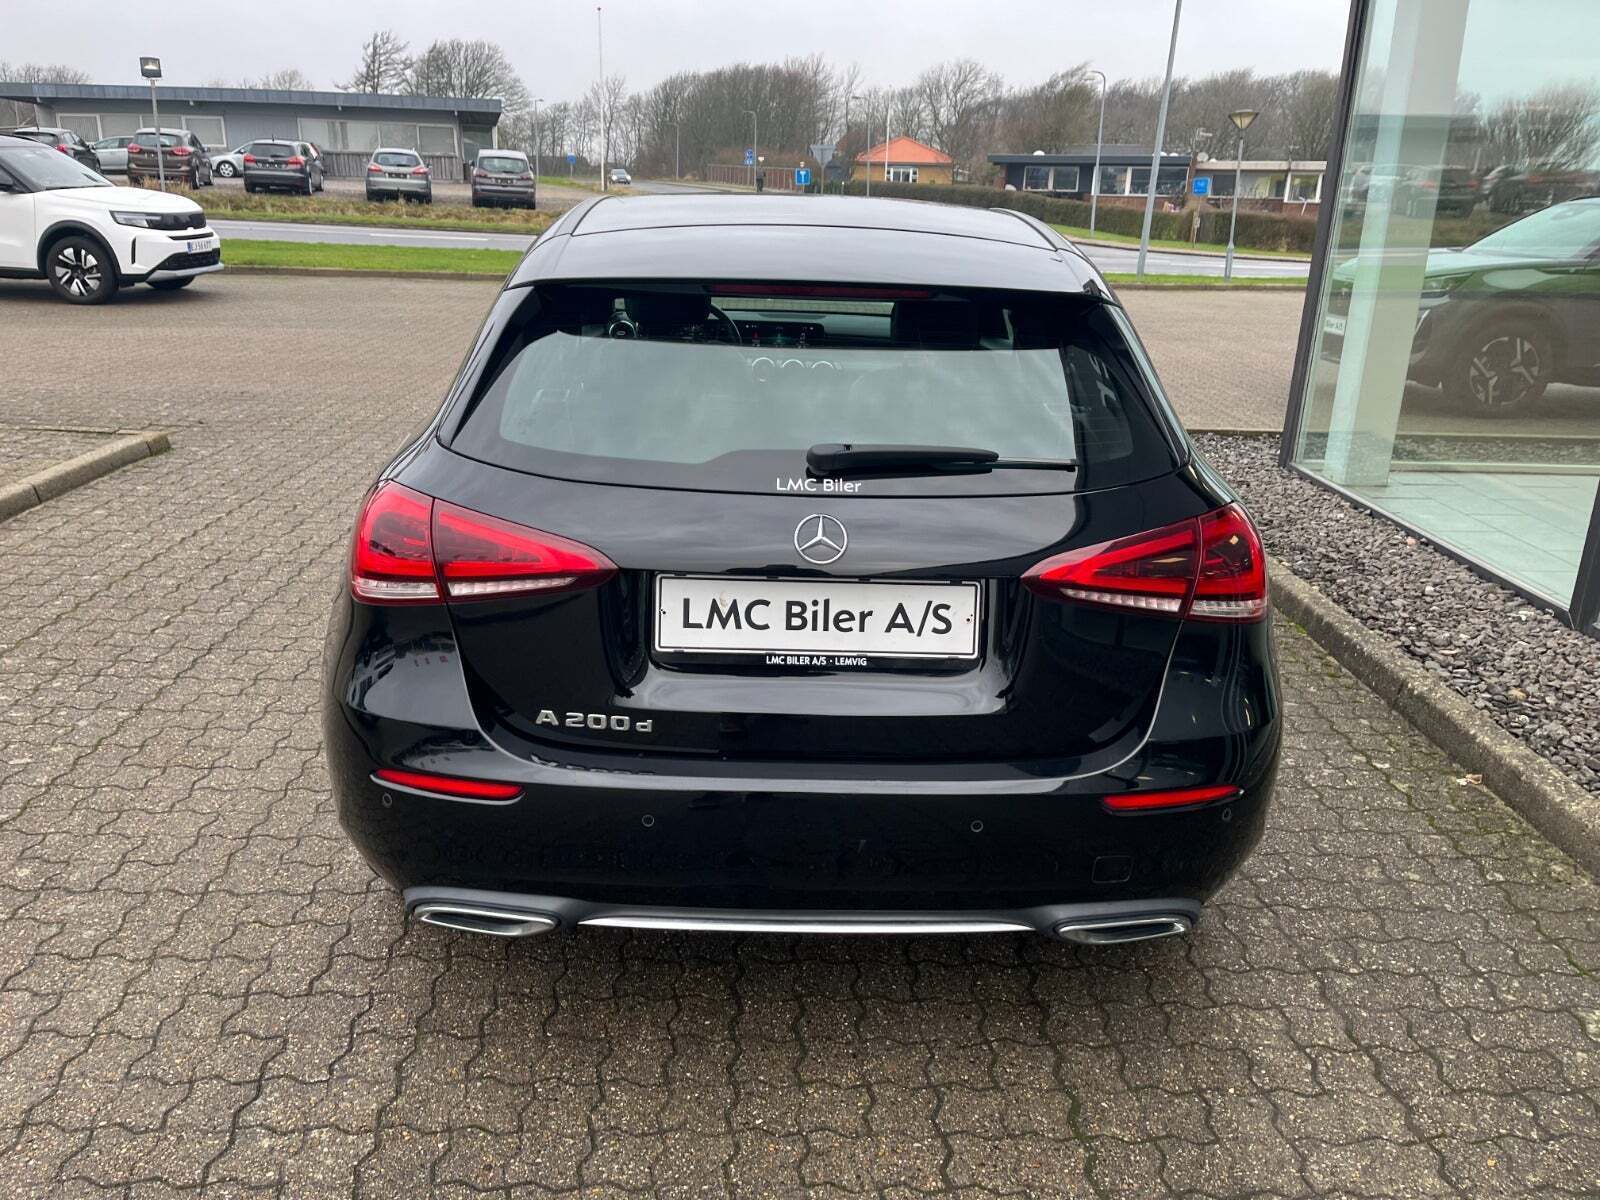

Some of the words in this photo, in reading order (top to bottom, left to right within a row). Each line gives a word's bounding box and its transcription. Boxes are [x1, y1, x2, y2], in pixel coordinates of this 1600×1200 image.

[776, 478, 817, 491] LMC
[823, 478, 862, 493] Biler
[682, 598, 771, 630] LMC
[785, 599, 874, 633] Biler
[884, 600, 954, 637] A/S
[766, 656, 785, 665] LMC
[786, 656, 810, 665] BILER
[811, 656, 827, 665] A/S
[835, 656, 867, 666] LEMVIG
[535, 709, 560, 726] A
[565, 712, 630, 731] 200
[635, 719, 653, 733] d
